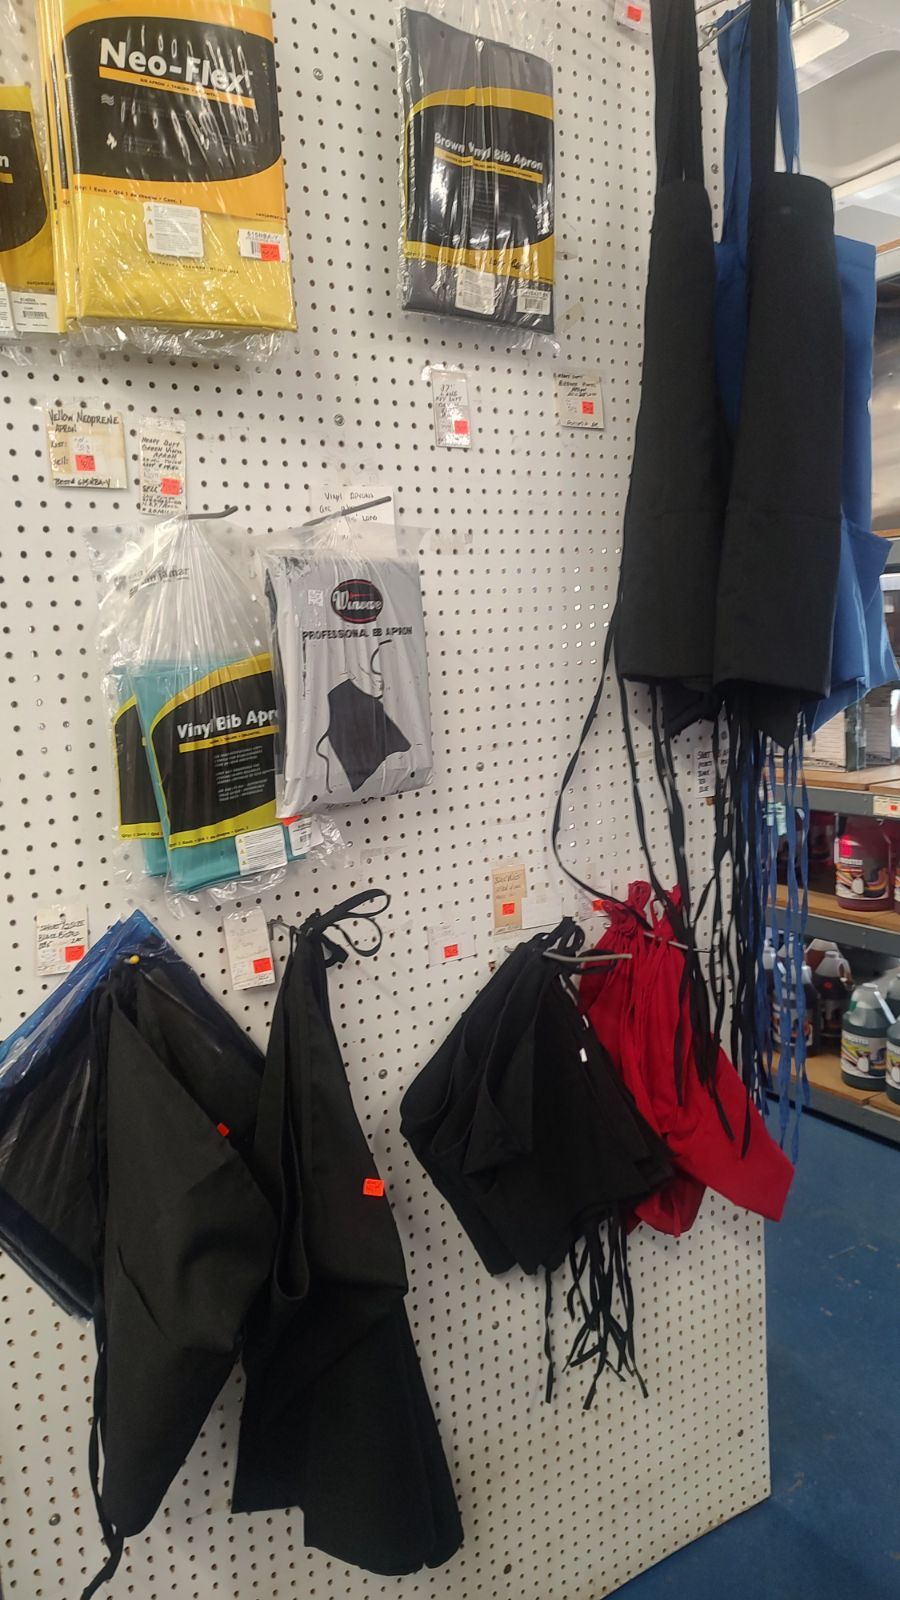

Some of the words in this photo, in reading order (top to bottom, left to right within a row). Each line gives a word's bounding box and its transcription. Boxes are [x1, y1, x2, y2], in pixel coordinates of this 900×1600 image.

[100, 37, 243, 94] Neo-Flex
[434, 131, 465, 154] Brown
[494, 148, 511, 162] Bib
[513, 155, 543, 173] Apron
[177, 719, 216, 739] Vinyl
[216, 713, 243, 732] Bib
